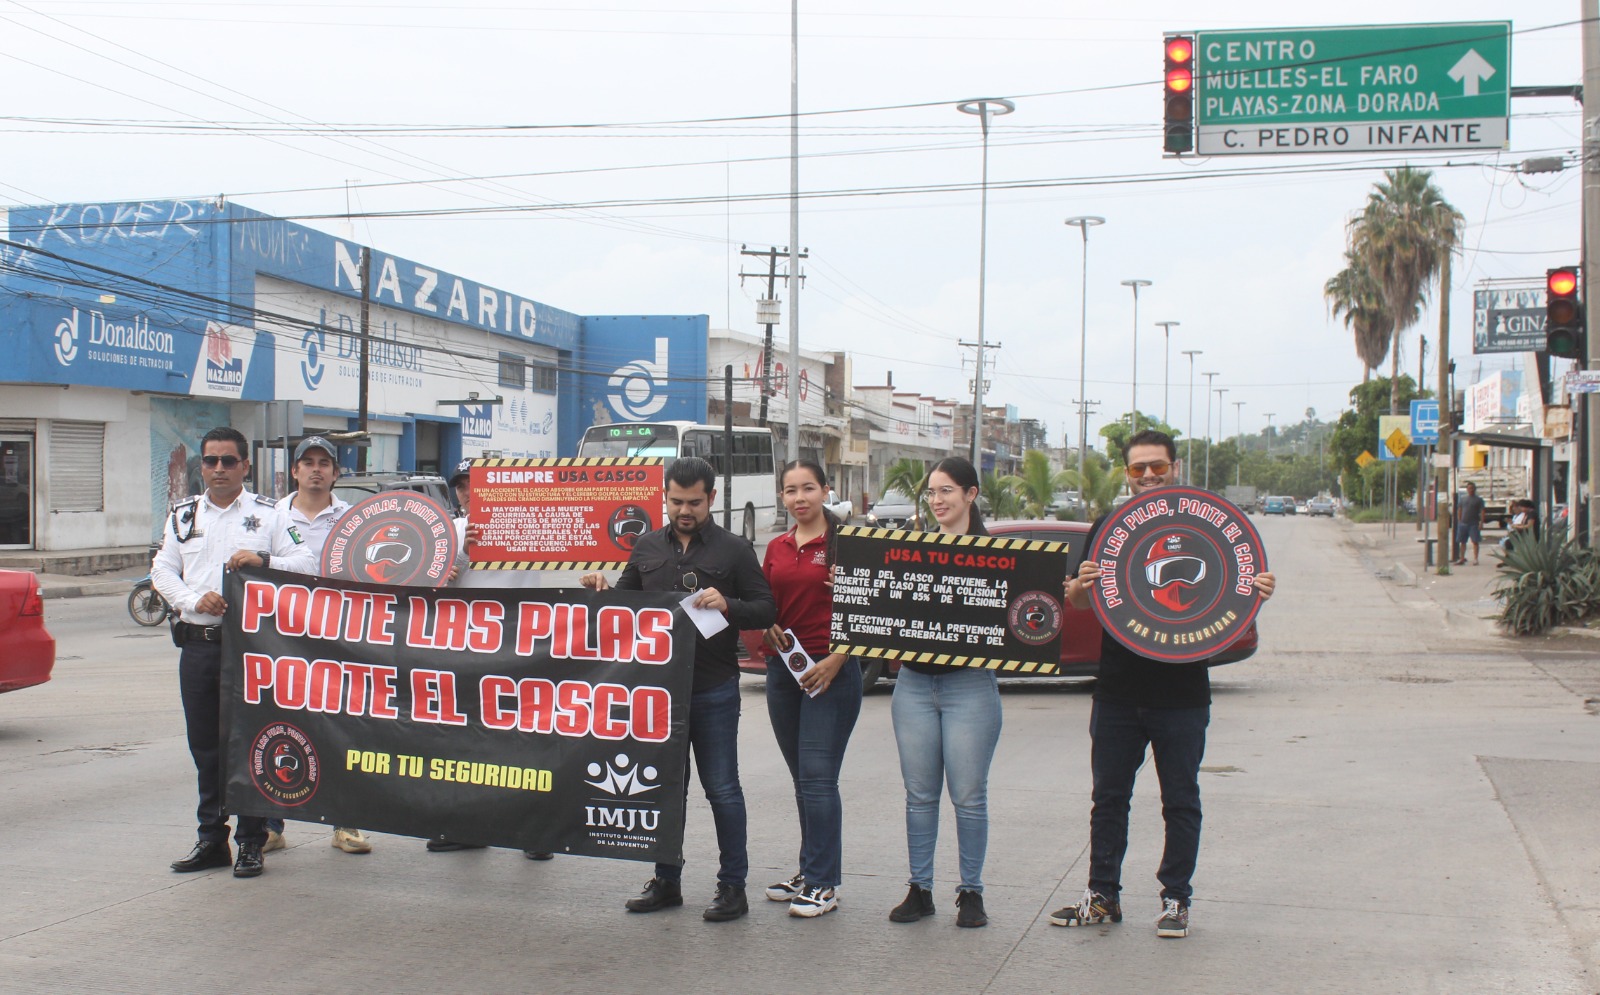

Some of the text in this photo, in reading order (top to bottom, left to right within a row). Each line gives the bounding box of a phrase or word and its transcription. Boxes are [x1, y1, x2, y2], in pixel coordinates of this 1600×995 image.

[1206, 40, 1315, 62] CENTRO
[1206, 64, 1418, 89] MUELLES-EL FARO
[1206, 91, 1439, 117] PLAYAS-ZONA DORADA
[1224, 124, 1481, 148] C. PEDRO INFANTE
[335, 241, 536, 338] NAZARIO
[89, 309, 173, 353] Donaldson
[88, 350, 173, 369] SOLUCIONES DE FILTRACION
[208, 369, 241, 383] NAZARIO
[339, 365, 422, 387] SOLUCNES DE FILTRACION
[487, 470, 647, 483] SIEMPRE USA CASCO
[330, 499, 448, 578] PONTE LAS PILAS, PONTE EL CASCO
[884, 548, 1015, 570] ¡USA TU CASCO!
[1100, 498, 1255, 609] PONTE LAS PILAS, PONTE EL CASCO
[834, 576, 1007, 598] MUERTE EN CASO DE UNA COLISIÓN Y
[835, 566, 1008, 589] EL USO DEL CASCO PREVIENE LA
[833, 594, 870, 606] GRAVES.
[834, 585, 1007, 608] DISMINUYE UN 85% DE LESIONES
[242, 580, 673, 664] PONTE LAS PILAS
[831, 622, 1004, 646] DE LESIONES CEREBRALES ES DEL
[832, 612, 1005, 636] SU EFECTIVIDAD EN LA PREVENCIÓN
[1127, 610, 1237, 645] POR TU SEGURIDAD
[831, 632, 850, 641] 73%.
[243, 652, 671, 743] PONTE EL CASCO
[346, 749, 553, 792] POR TU SEGURIDAD
[584, 806, 661, 831] IMJU
[623, 834, 657, 842] MUNICIPAL
